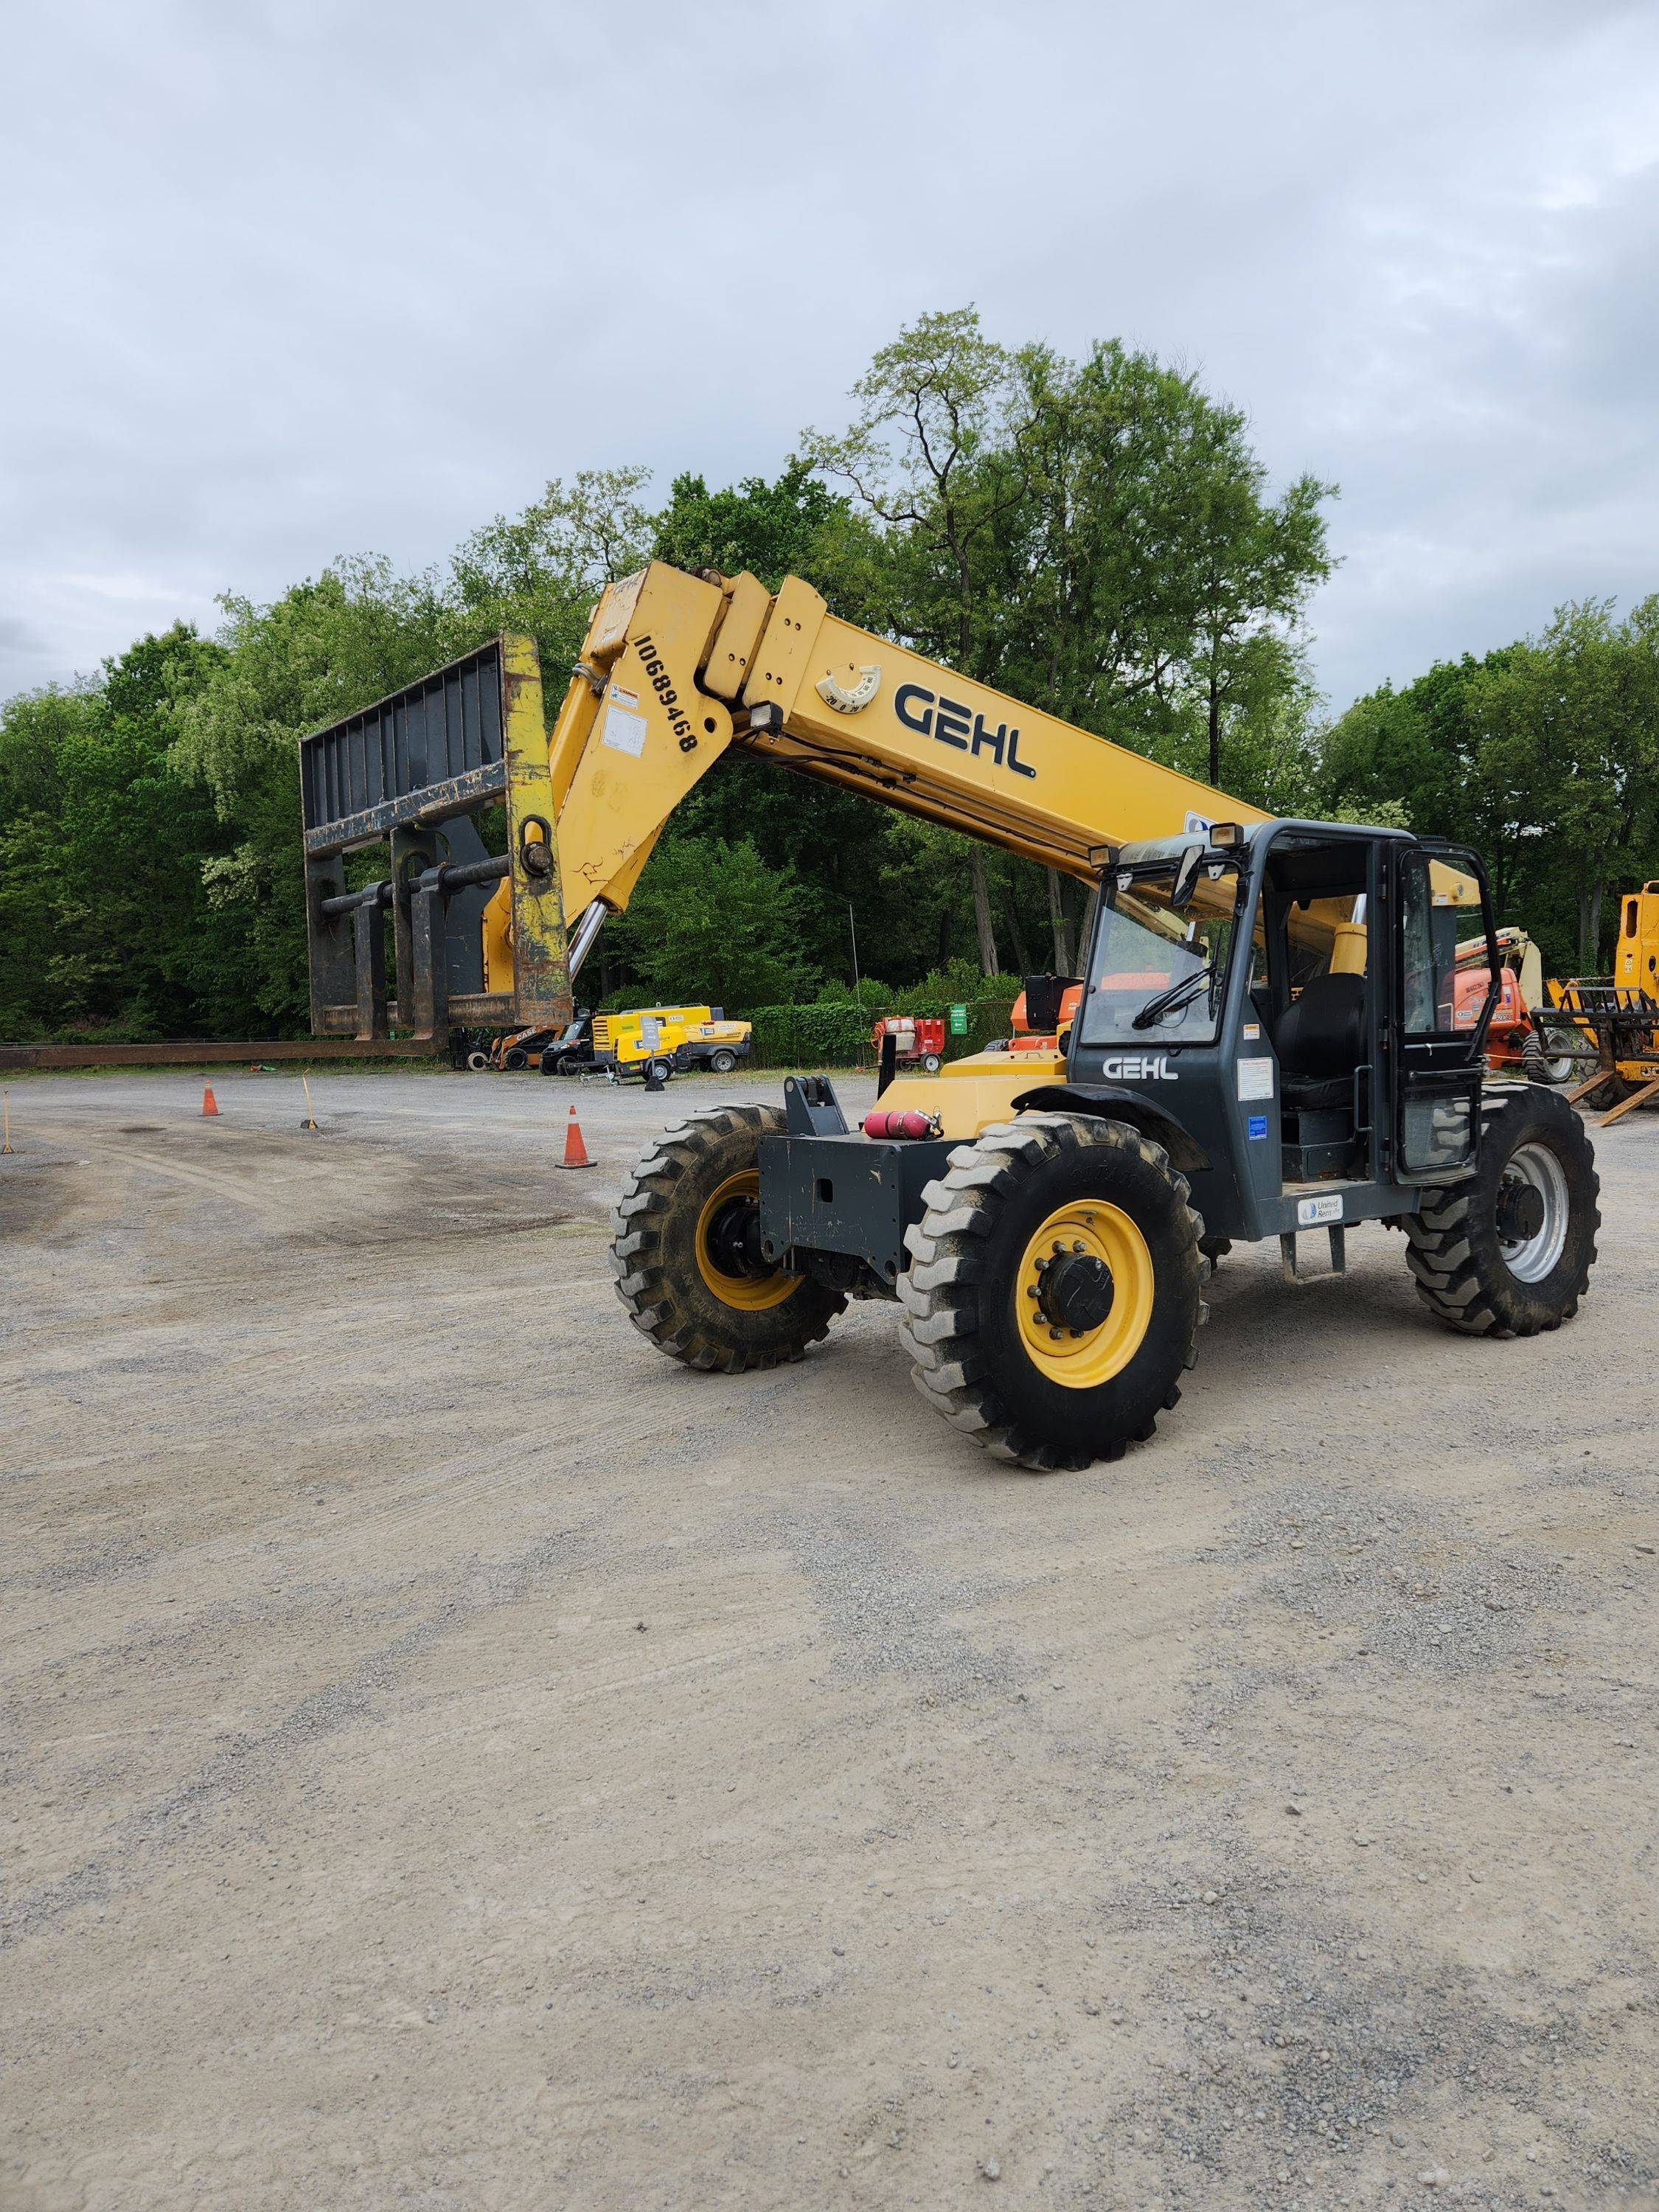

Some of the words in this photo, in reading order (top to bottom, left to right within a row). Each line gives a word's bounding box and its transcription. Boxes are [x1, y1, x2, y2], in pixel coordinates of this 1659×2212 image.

[634, 636, 698, 752] 10689468
[826, 695, 838, 706] -20
[894, 683, 1037, 779] GEHL
[517, 1027, 538, 1041] CASE
[1103, 1057, 1179, 1080] GEHL
[1318, 1199, 1338, 1209] United
[1318, 1208, 1340, 1217] Rentl
